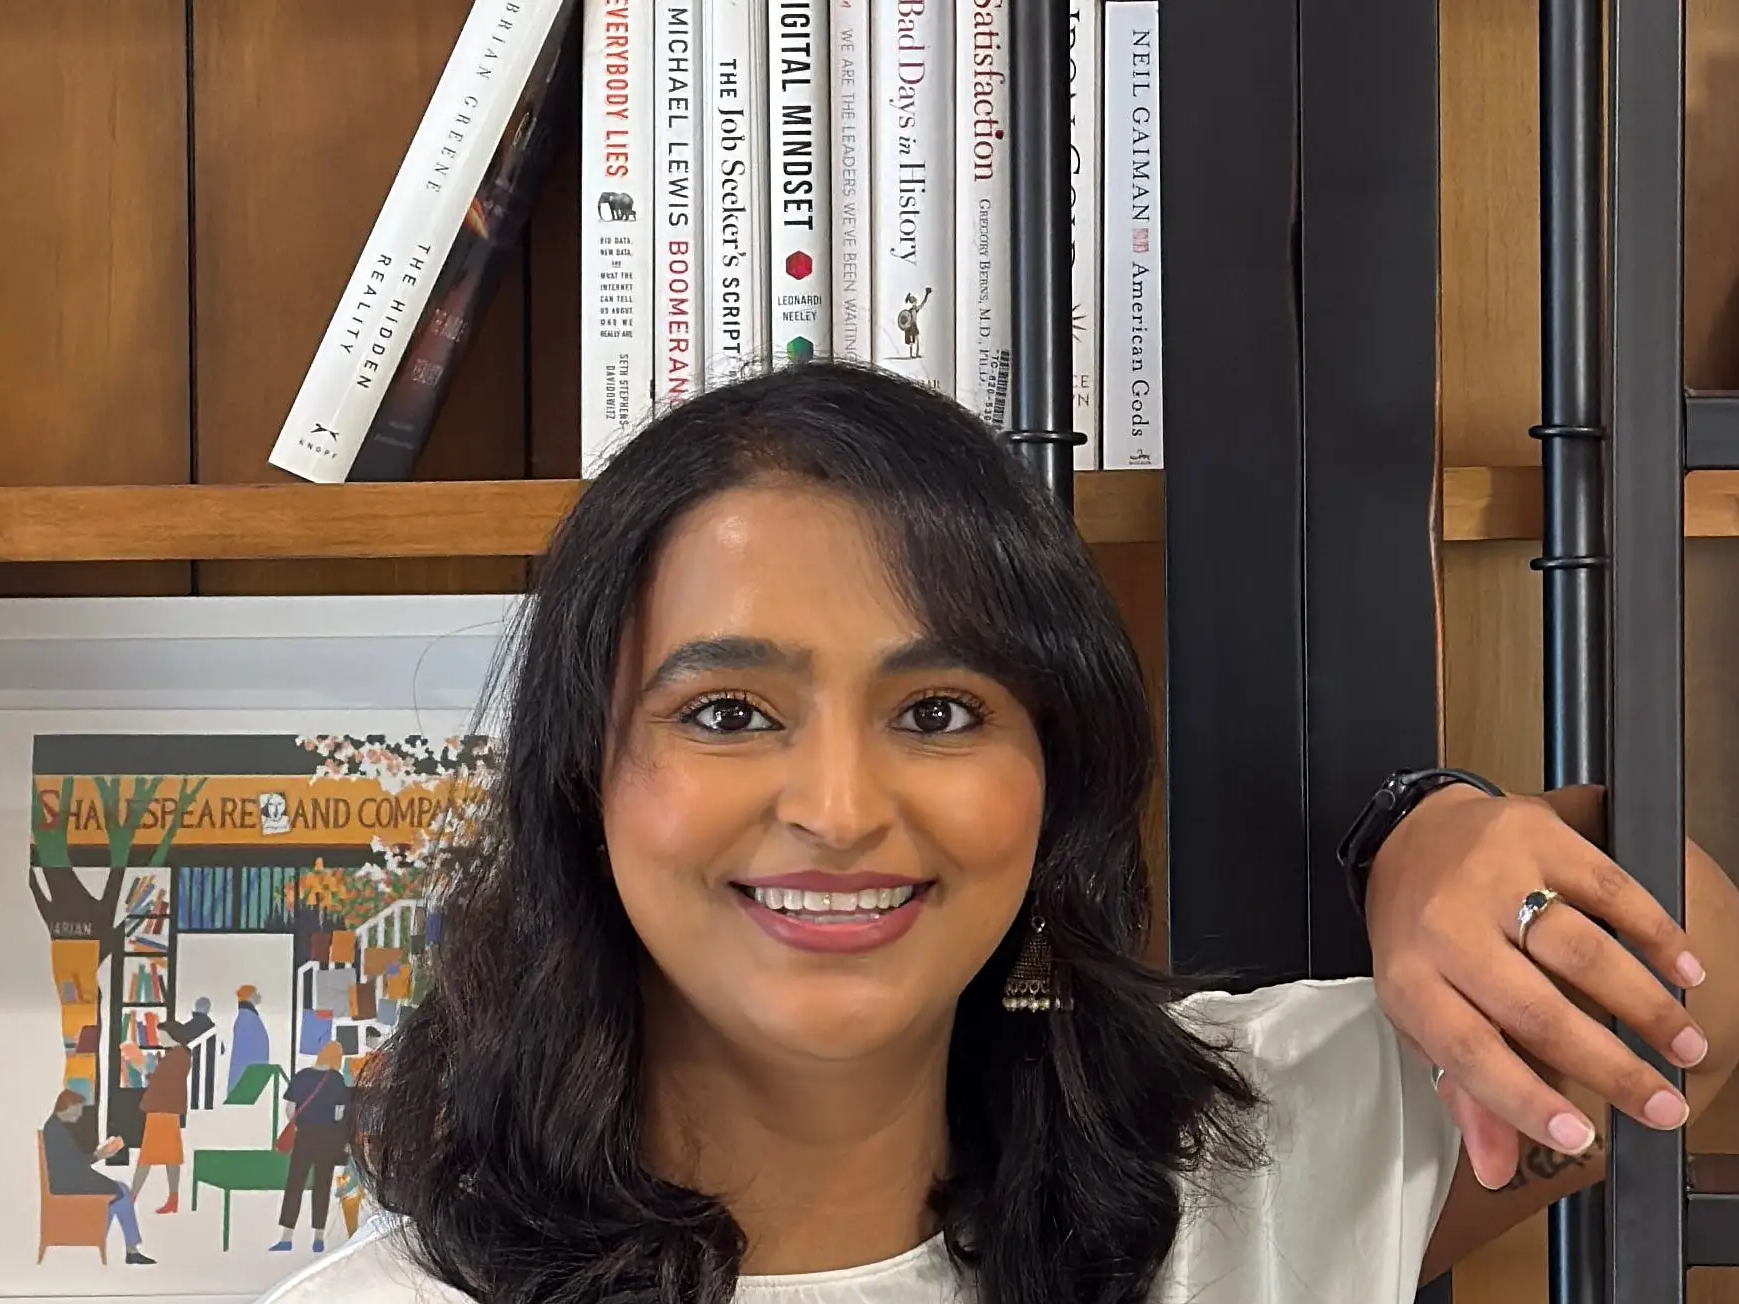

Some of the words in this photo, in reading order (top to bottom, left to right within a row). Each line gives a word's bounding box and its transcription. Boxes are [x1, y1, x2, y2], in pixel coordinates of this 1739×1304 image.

[897, 0, 926, 50] Bad
[668, 8, 689, 128] MICHAEL
[890, 62, 926, 129] Days
[1132, 30, 1150, 98] NEIL
[605, 130, 628, 178] LIES
[782, 105, 813, 230] MINDSET
[898, 136, 916, 155] in
[1132, 106, 1150, 222] GAIMAN
[668, 142, 689, 227] LEWIS
[890, 162, 926, 266] History
[401, 245, 430, 287] THE
[339, 254, 392, 355] REALITY
[778, 295, 822, 306] LEONARDI
[782, 311, 818, 321] NEELEY
[1132, 261, 1150, 372] American
[356, 300, 406, 390] HIDDEN
[1132, 380, 1150, 437] Gods
[291, 797, 350, 830] AND
